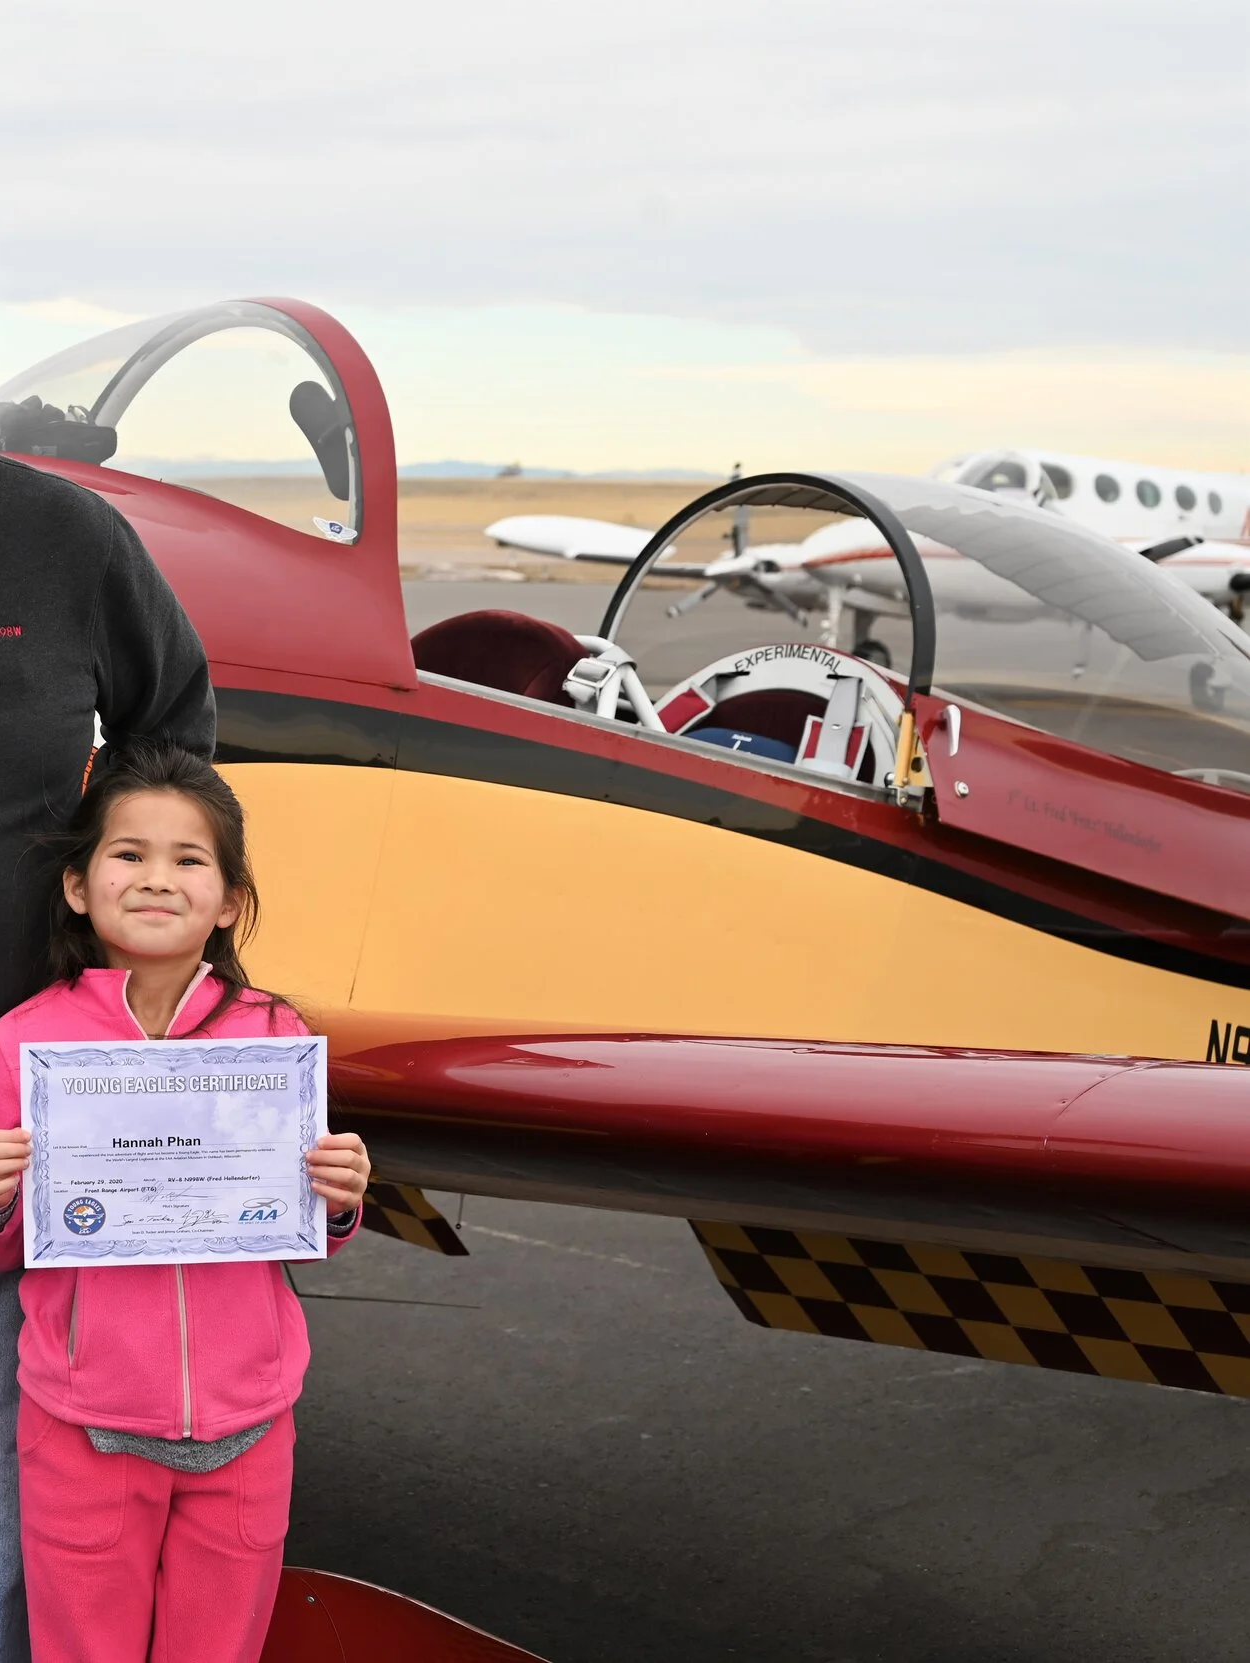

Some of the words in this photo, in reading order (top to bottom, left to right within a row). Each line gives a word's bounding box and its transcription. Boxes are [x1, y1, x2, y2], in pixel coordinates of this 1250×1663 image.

[734, 644, 841, 674] EXPERIMENTAL
[62, 1078, 122, 1094] YOUNG
[124, 1076, 186, 1094] EAGLES
[190, 1074, 288, 1092] CERTIFICATE
[112, 1137, 162, 1148] Hannah
[168, 1136, 200, 1146] Phan
[238, 1209, 278, 1221] EAA
